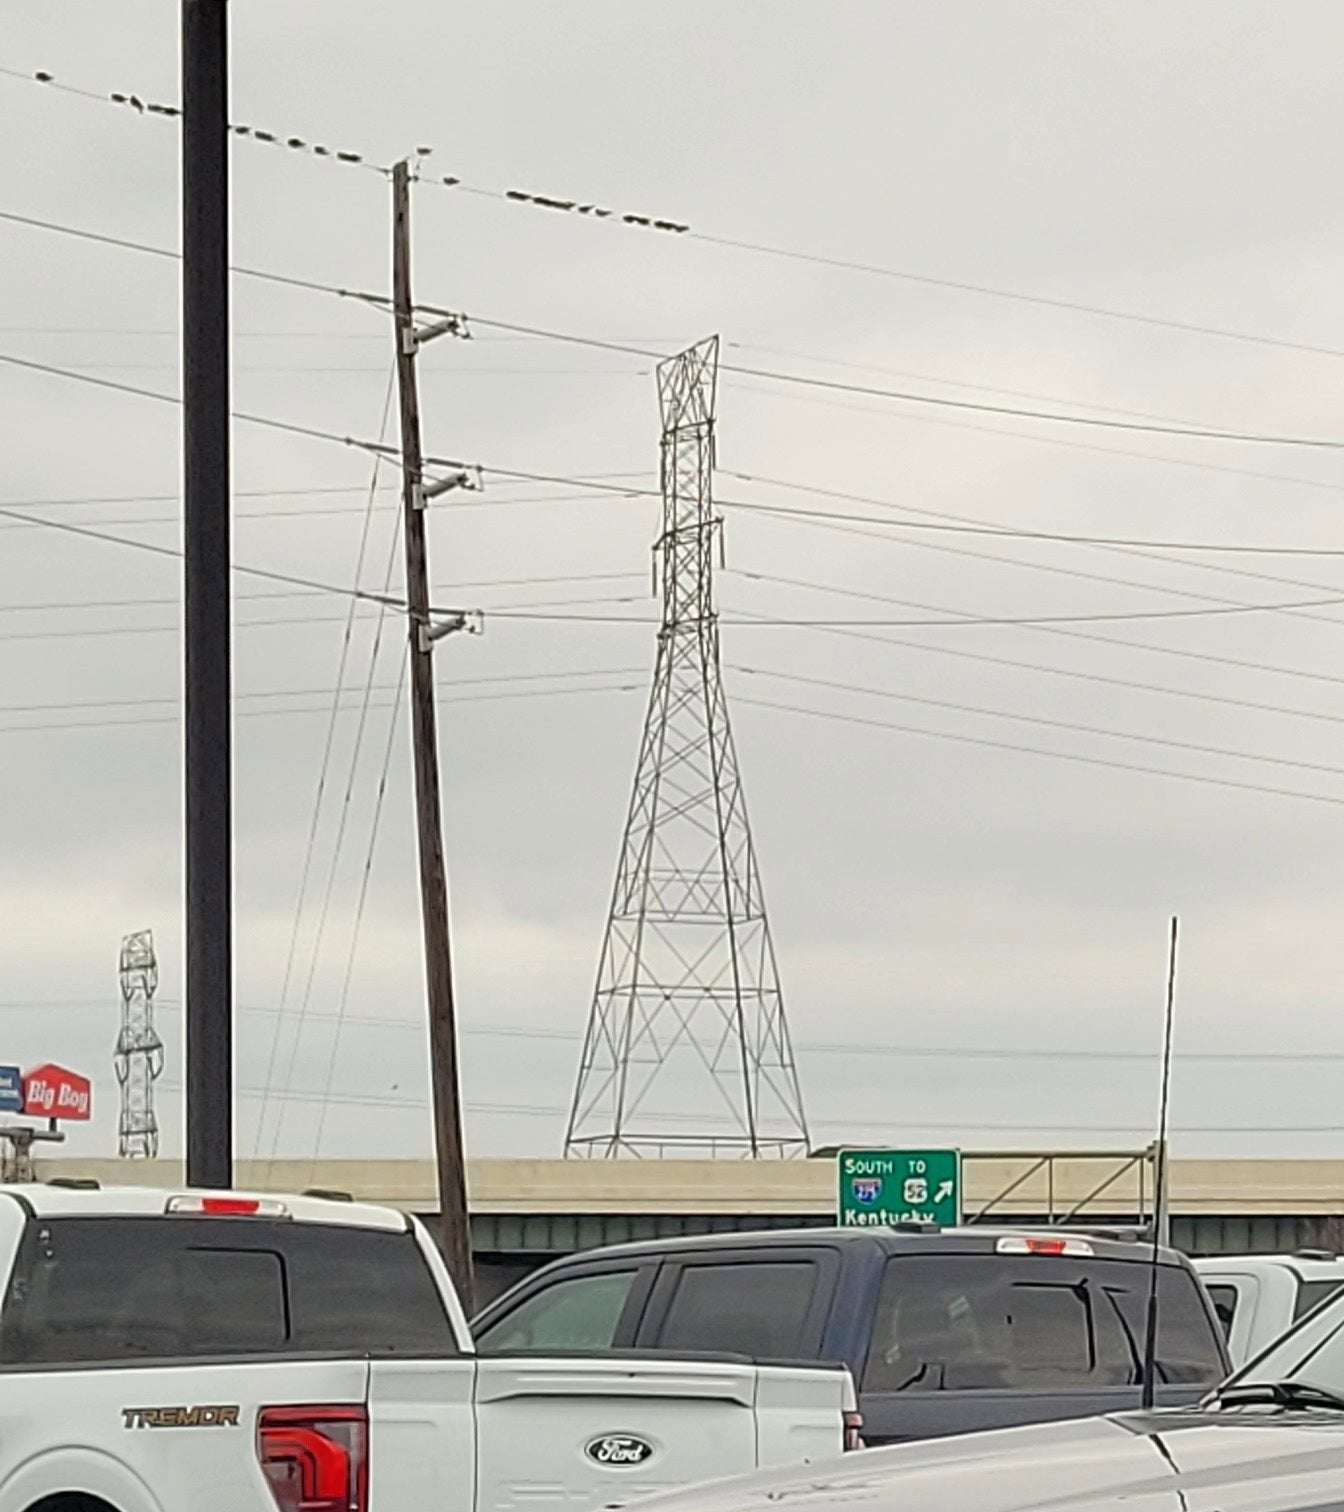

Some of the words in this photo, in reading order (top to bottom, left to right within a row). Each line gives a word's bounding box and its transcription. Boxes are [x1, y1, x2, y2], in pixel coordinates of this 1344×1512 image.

[28, 1080, 55, 1110] Big
[58, 1083, 88, 1113] Boy
[845, 1159, 893, 1174] SOUTH
[908, 1160, 926, 1174] TO
[907, 1184, 925, 1199] 52
[845, 1209, 935, 1225] Kentucky
[122, 1405, 240, 1428] TREMOR
[597, 1439, 643, 1462] Ford
